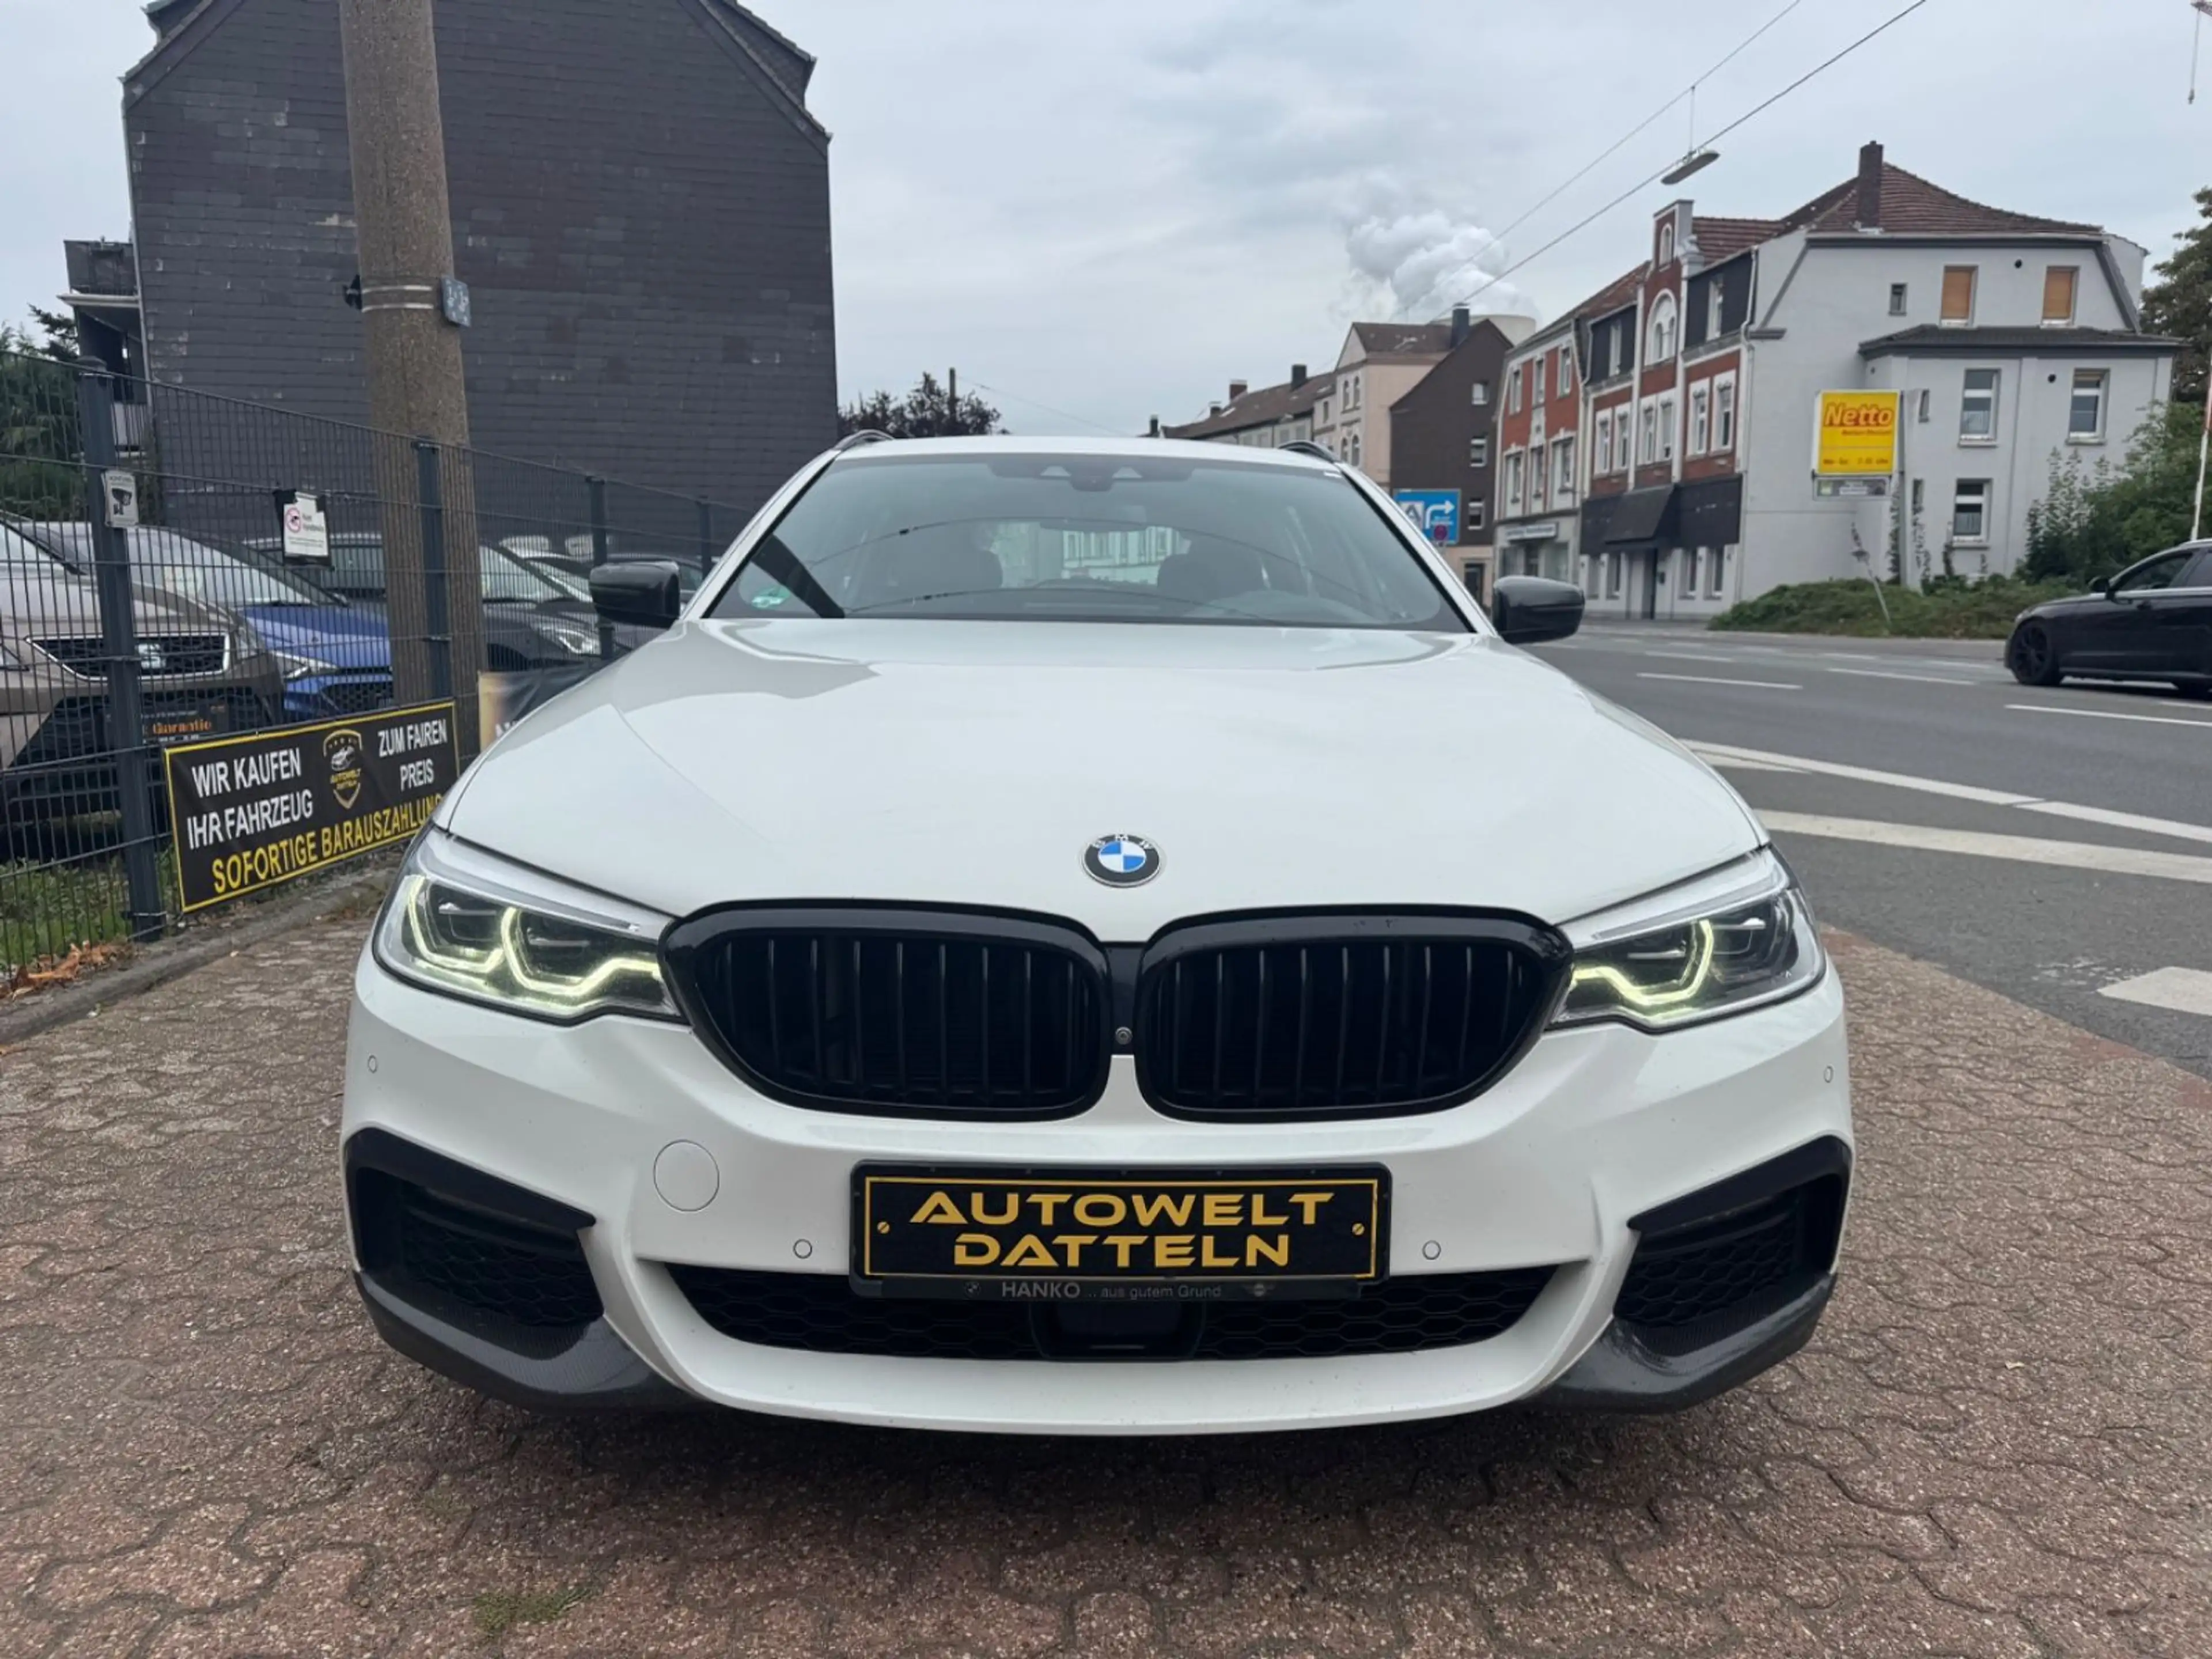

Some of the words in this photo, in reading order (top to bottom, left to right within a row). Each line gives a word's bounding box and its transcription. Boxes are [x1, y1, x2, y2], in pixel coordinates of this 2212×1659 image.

[1823, 402, 1895, 427] Netto
[378, 726, 406, 757] ZUM
[407, 719, 448, 750] FAIREN
[191, 760, 231, 798] WIR
[233, 747, 301, 790] KAUFEN
[400, 758, 435, 791] PREIS
[187, 811, 224, 850] IHR
[224, 789, 313, 840] FAHRZEUG
[213, 831, 318, 893] SOFORTIGE
[908, 1191, 1335, 1226] AUTOWELT
[954, 1233, 1289, 1267] DATTELN
[1002, 1282, 1081, 1298] HANKO
[1177, 1284, 1222, 1298] Grund
